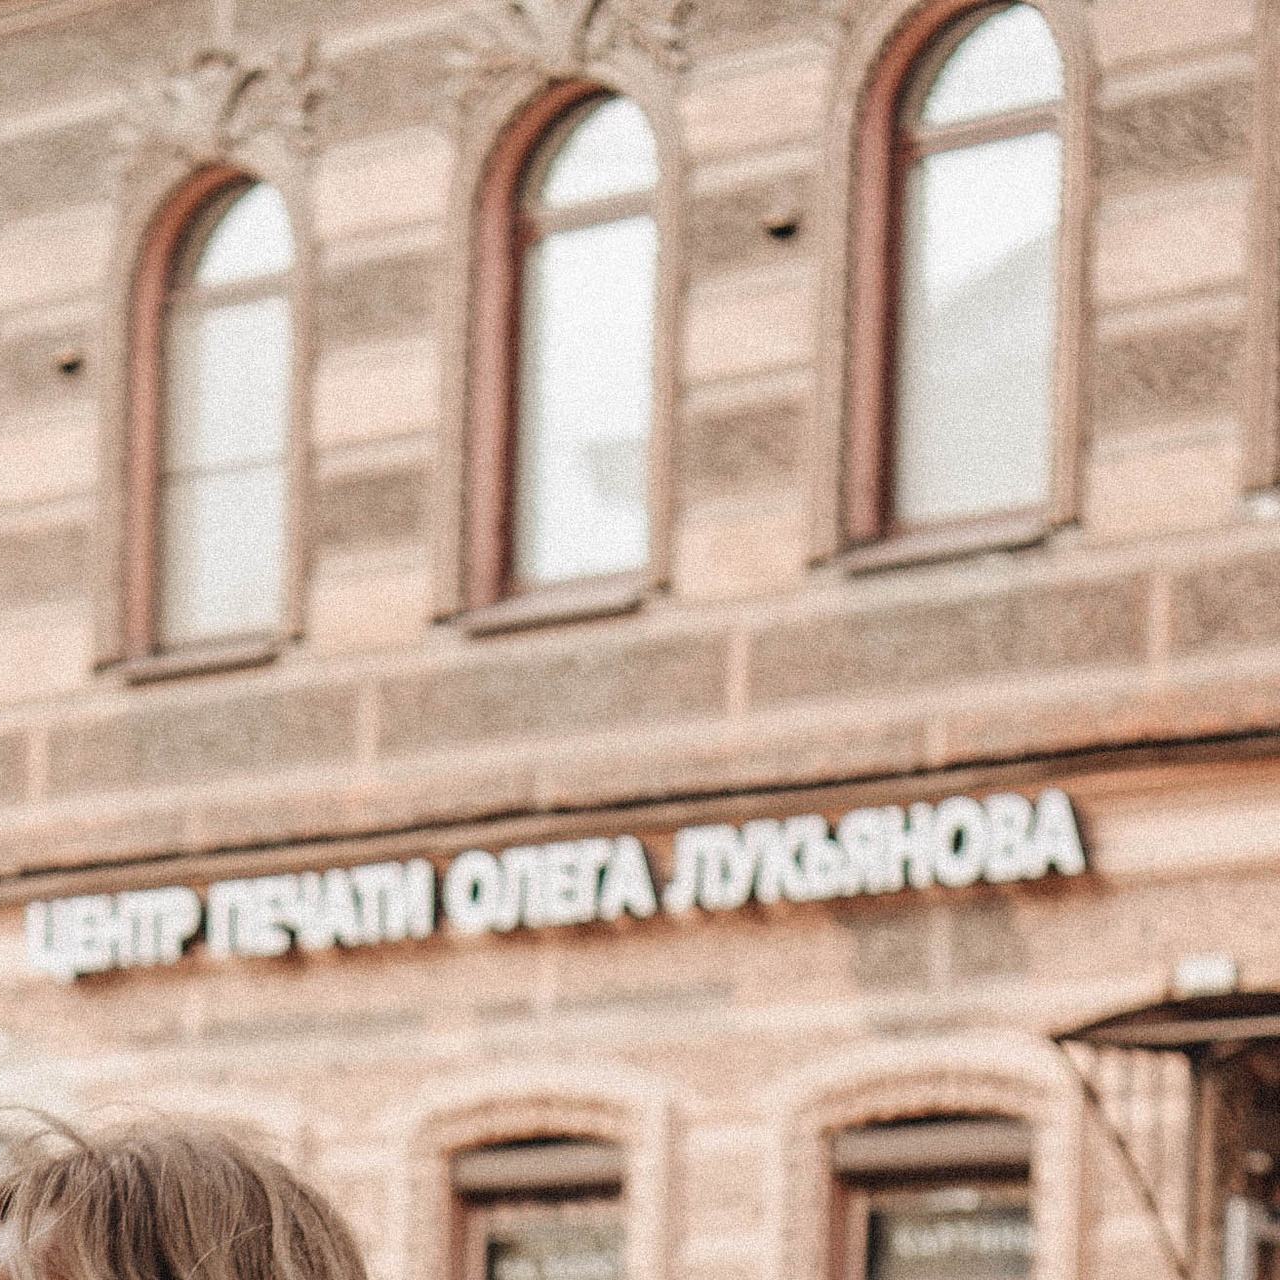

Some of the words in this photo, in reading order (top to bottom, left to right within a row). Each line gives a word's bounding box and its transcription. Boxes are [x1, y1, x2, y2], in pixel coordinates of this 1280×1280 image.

[26, 885, 203, 984] ЦЕНТР
[205, 856, 437, 961] ПЕЧАТИ
[442, 834, 658, 937] ОЛЕГА
[661, 787, 1087, 916] ЛУКЬЯНОВА
